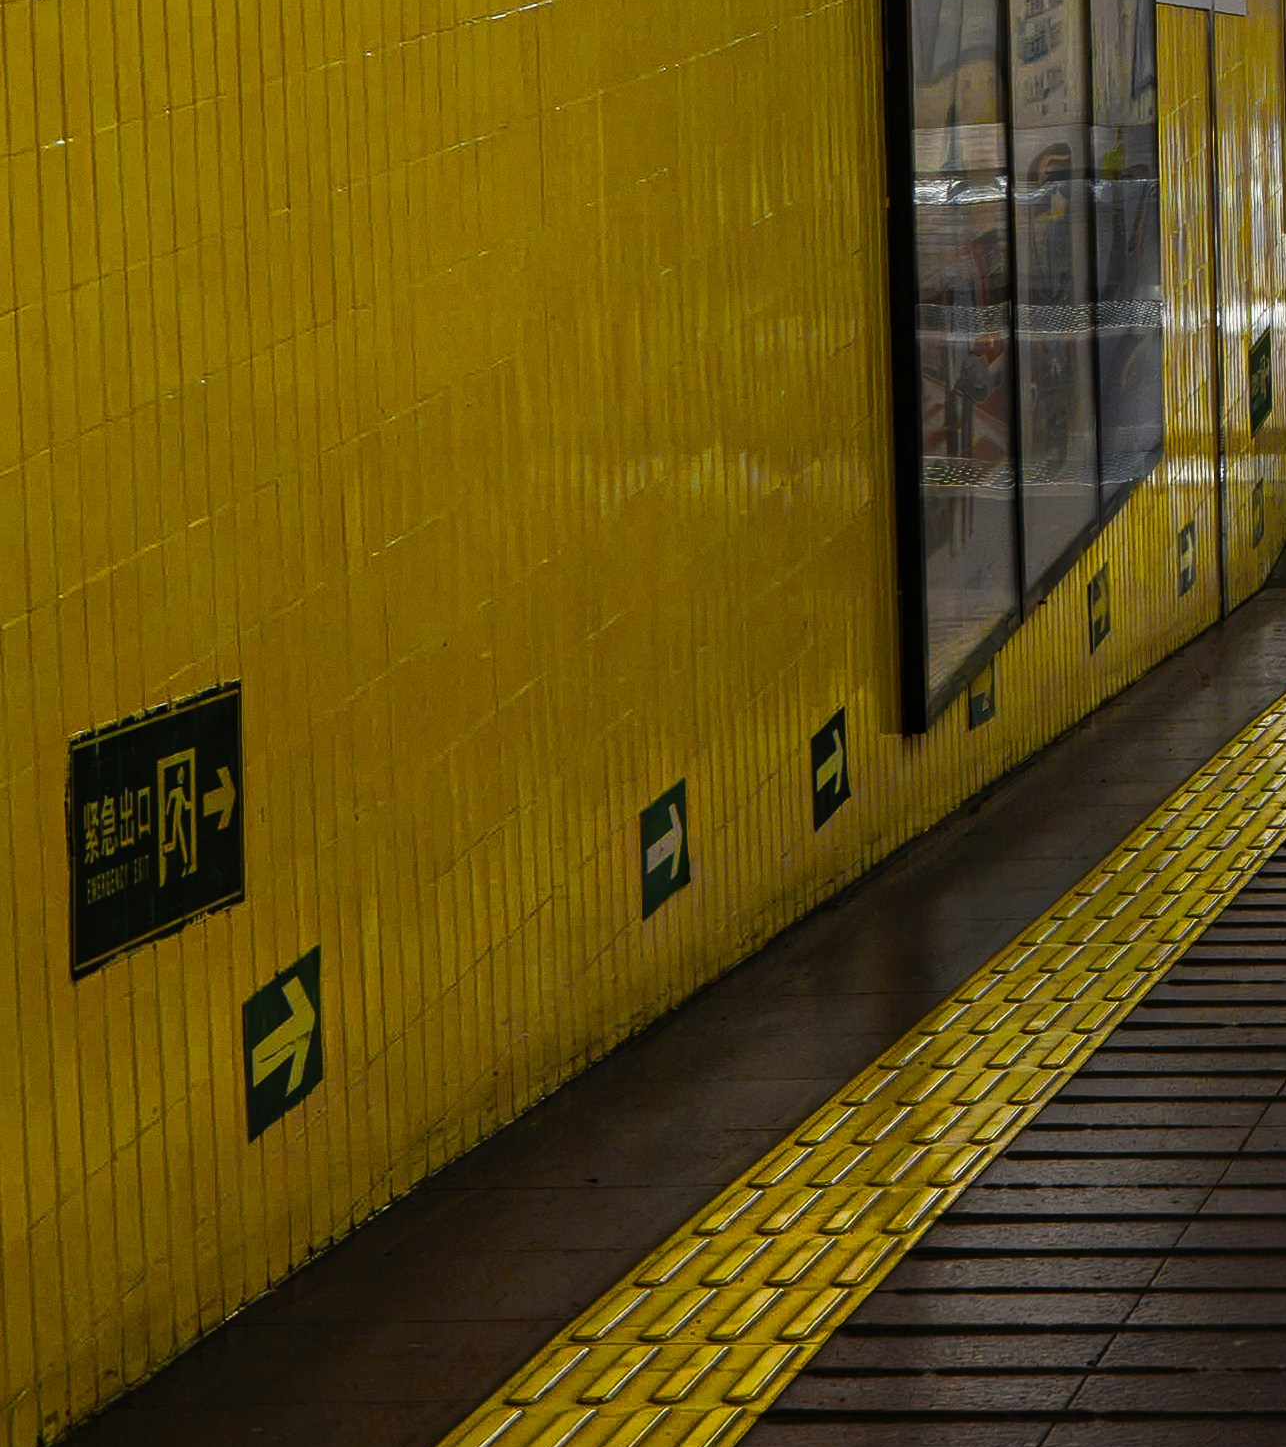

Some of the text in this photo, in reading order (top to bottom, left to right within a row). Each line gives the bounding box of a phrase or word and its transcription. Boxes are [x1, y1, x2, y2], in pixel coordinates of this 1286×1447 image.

[83, 786, 151, 864] 緊急出口
[134, 854, 150, 884] EXIT
